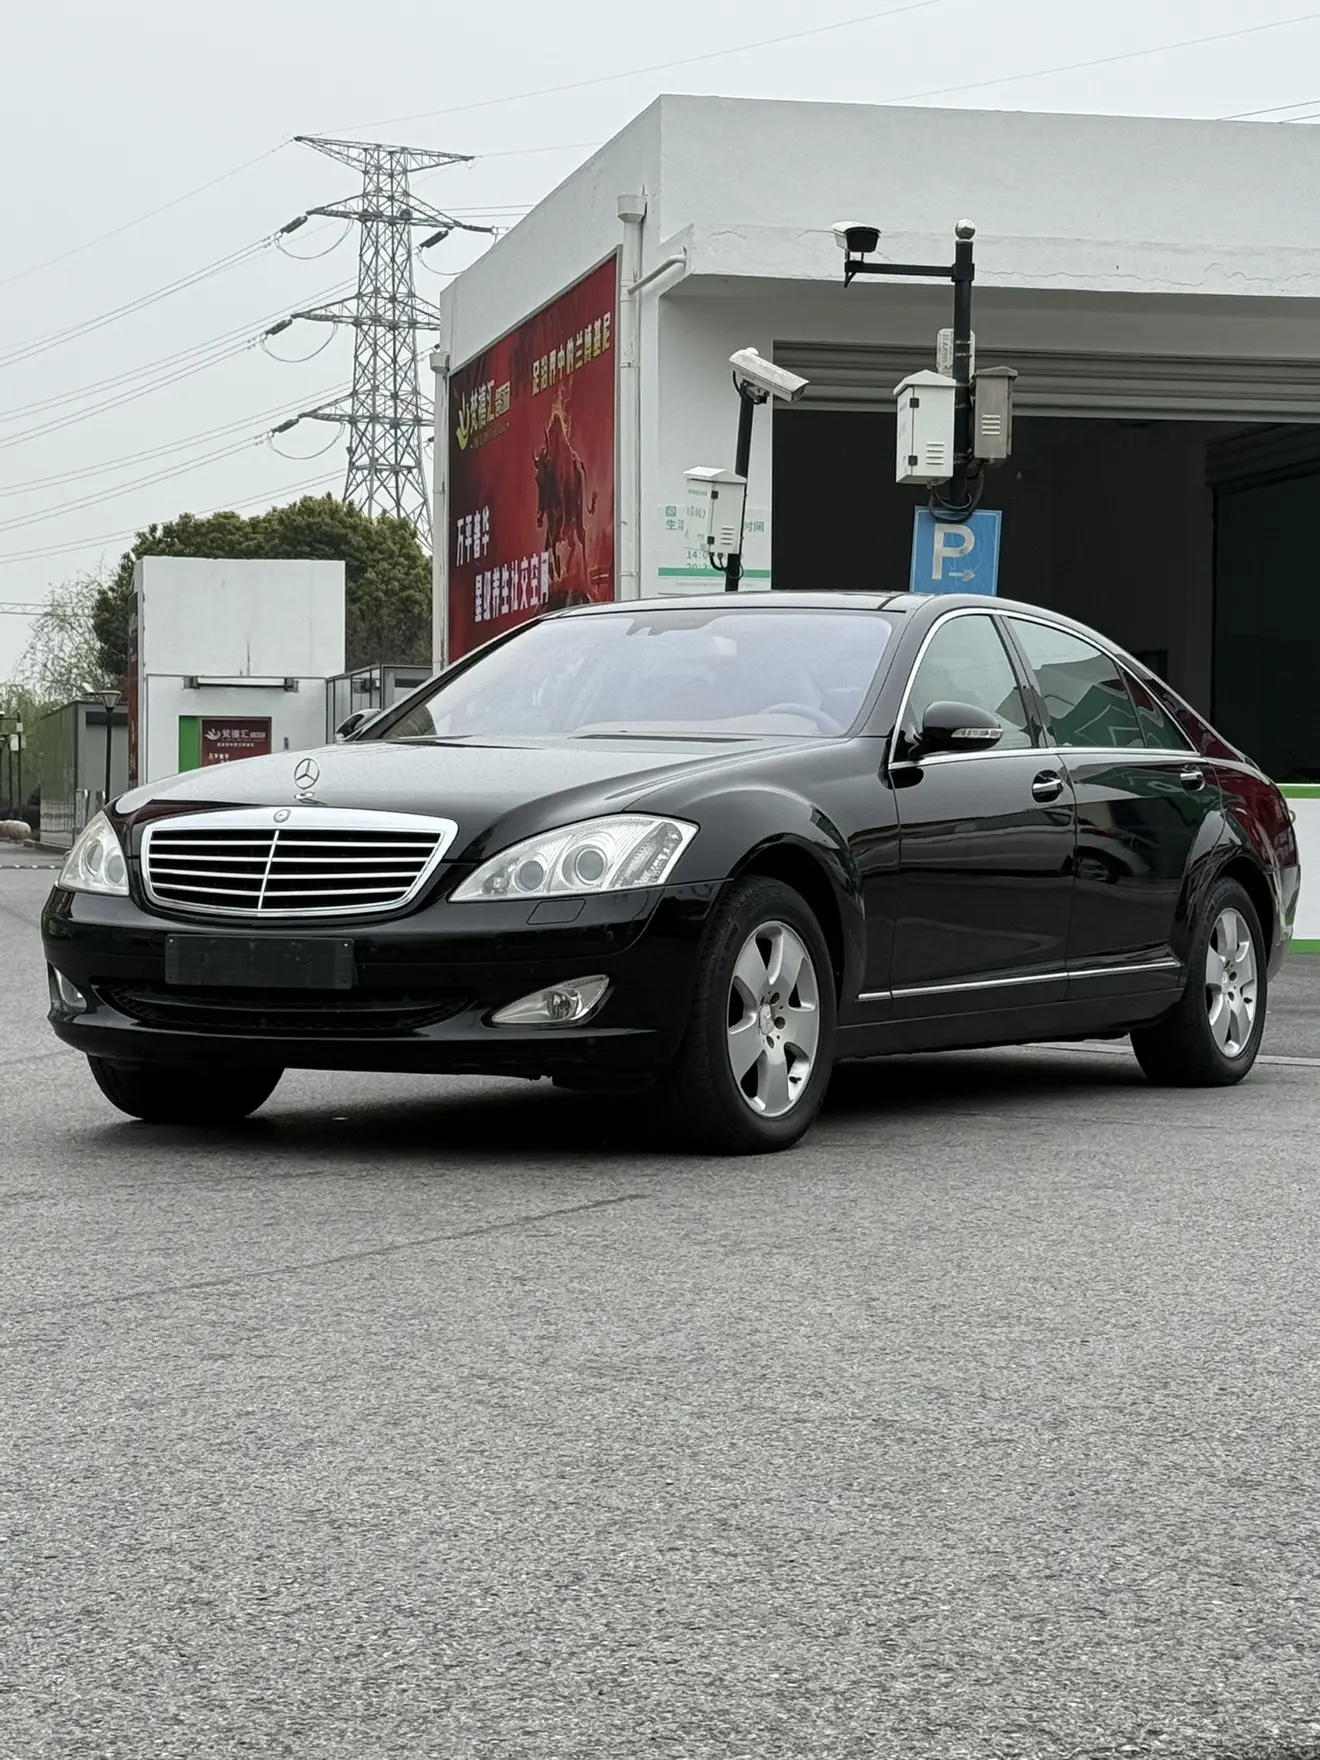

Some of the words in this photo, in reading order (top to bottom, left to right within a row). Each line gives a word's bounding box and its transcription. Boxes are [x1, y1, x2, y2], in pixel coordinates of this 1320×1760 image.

[932, 523, 975, 579] P
[474, 551, 550, 623] 星级养生社交空间
